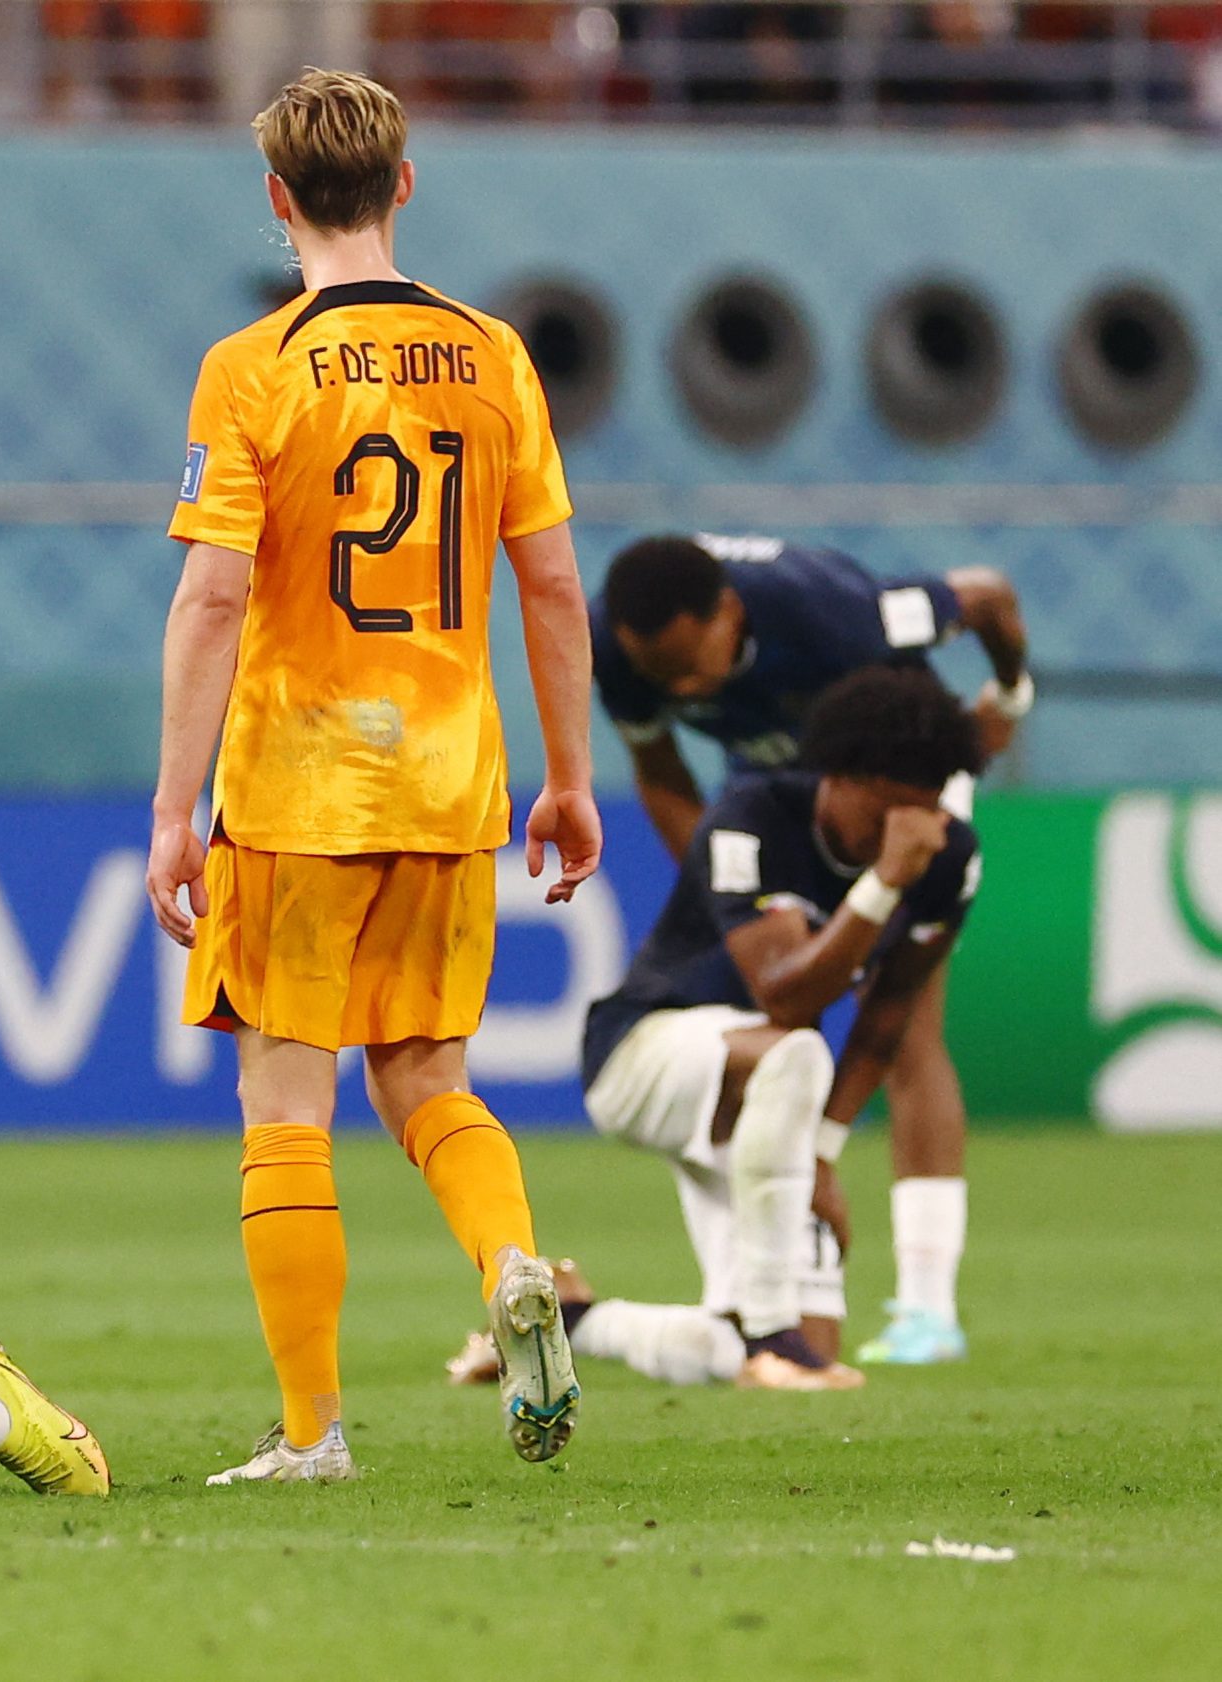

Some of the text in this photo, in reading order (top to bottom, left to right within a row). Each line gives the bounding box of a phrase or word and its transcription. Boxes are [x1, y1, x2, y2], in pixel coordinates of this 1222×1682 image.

[309, 342, 476, 389] F. DE JONG
[329, 431, 463, 632] 21
